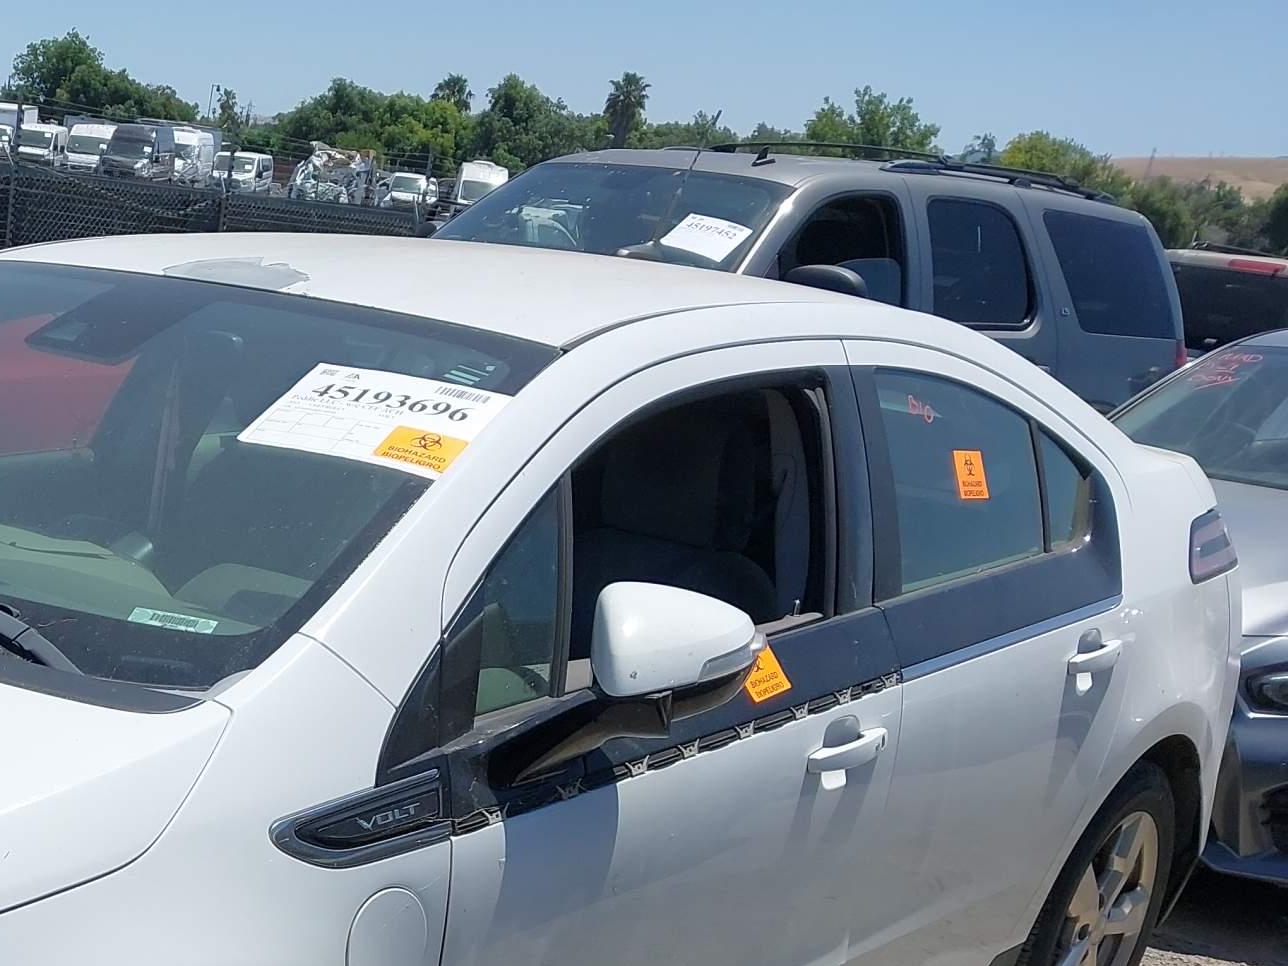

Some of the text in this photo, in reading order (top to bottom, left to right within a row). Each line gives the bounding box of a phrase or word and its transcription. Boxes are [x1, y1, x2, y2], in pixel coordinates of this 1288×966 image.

[311, 383, 473, 422] 45193696
[381, 450, 441, 471] BIOPELIGRO
[387, 445, 447, 464] BIOHAZARD
[354, 802, 420, 831] VOLT
